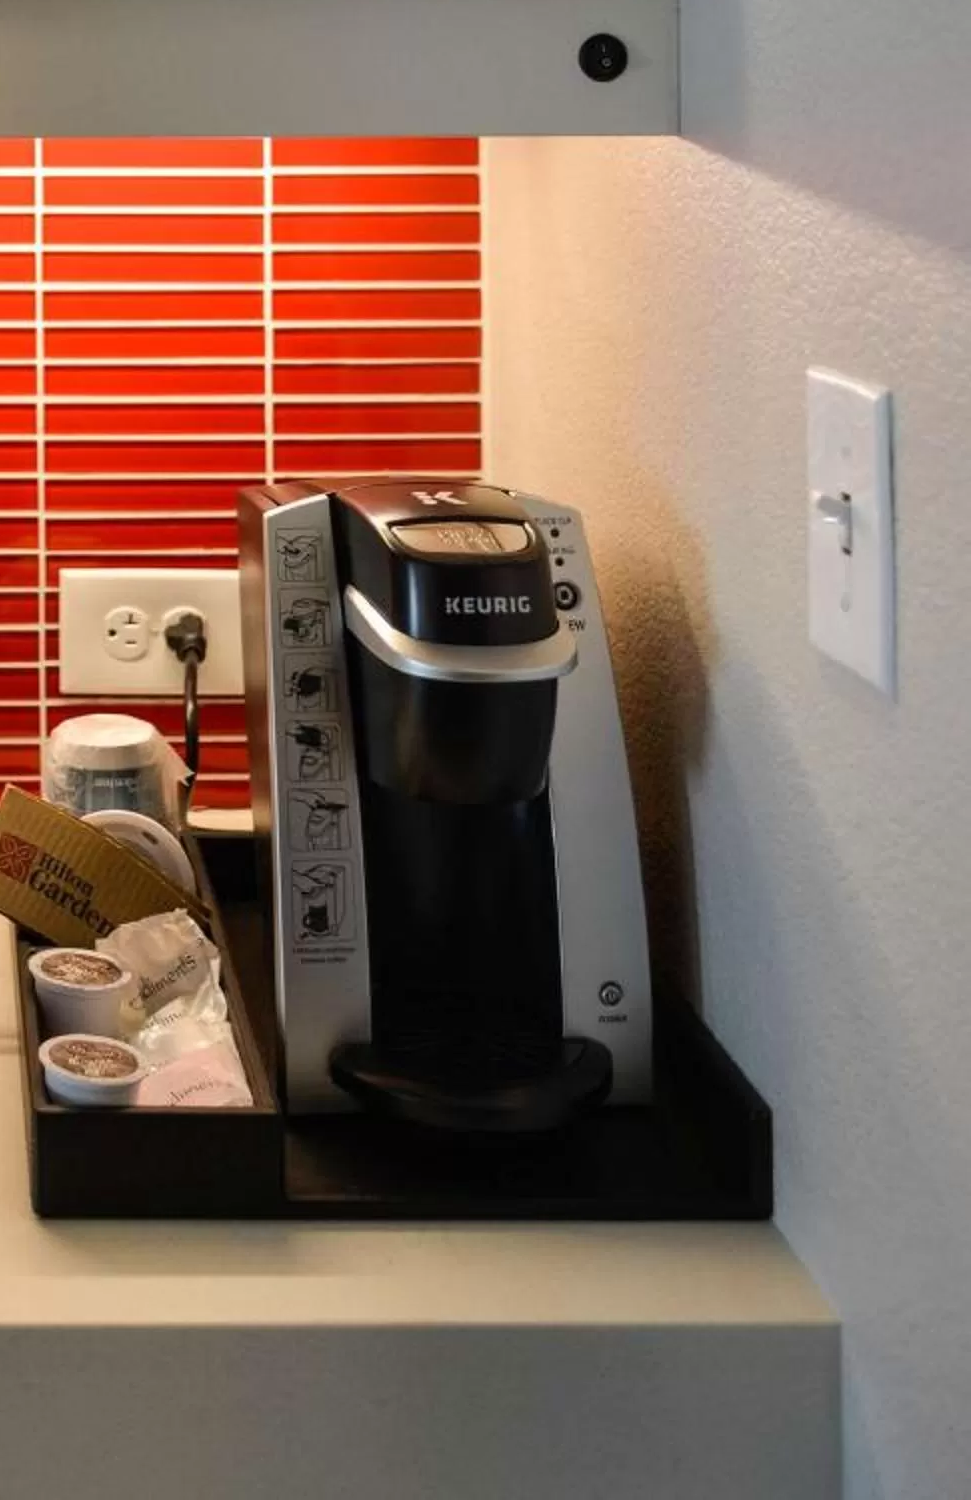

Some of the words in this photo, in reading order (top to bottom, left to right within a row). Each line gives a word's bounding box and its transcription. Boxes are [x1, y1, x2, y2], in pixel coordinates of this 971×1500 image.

[445, 595, 531, 614] KEURIG
[39, 852, 94, 897] Hilton
[29, 868, 115, 938] Garden
